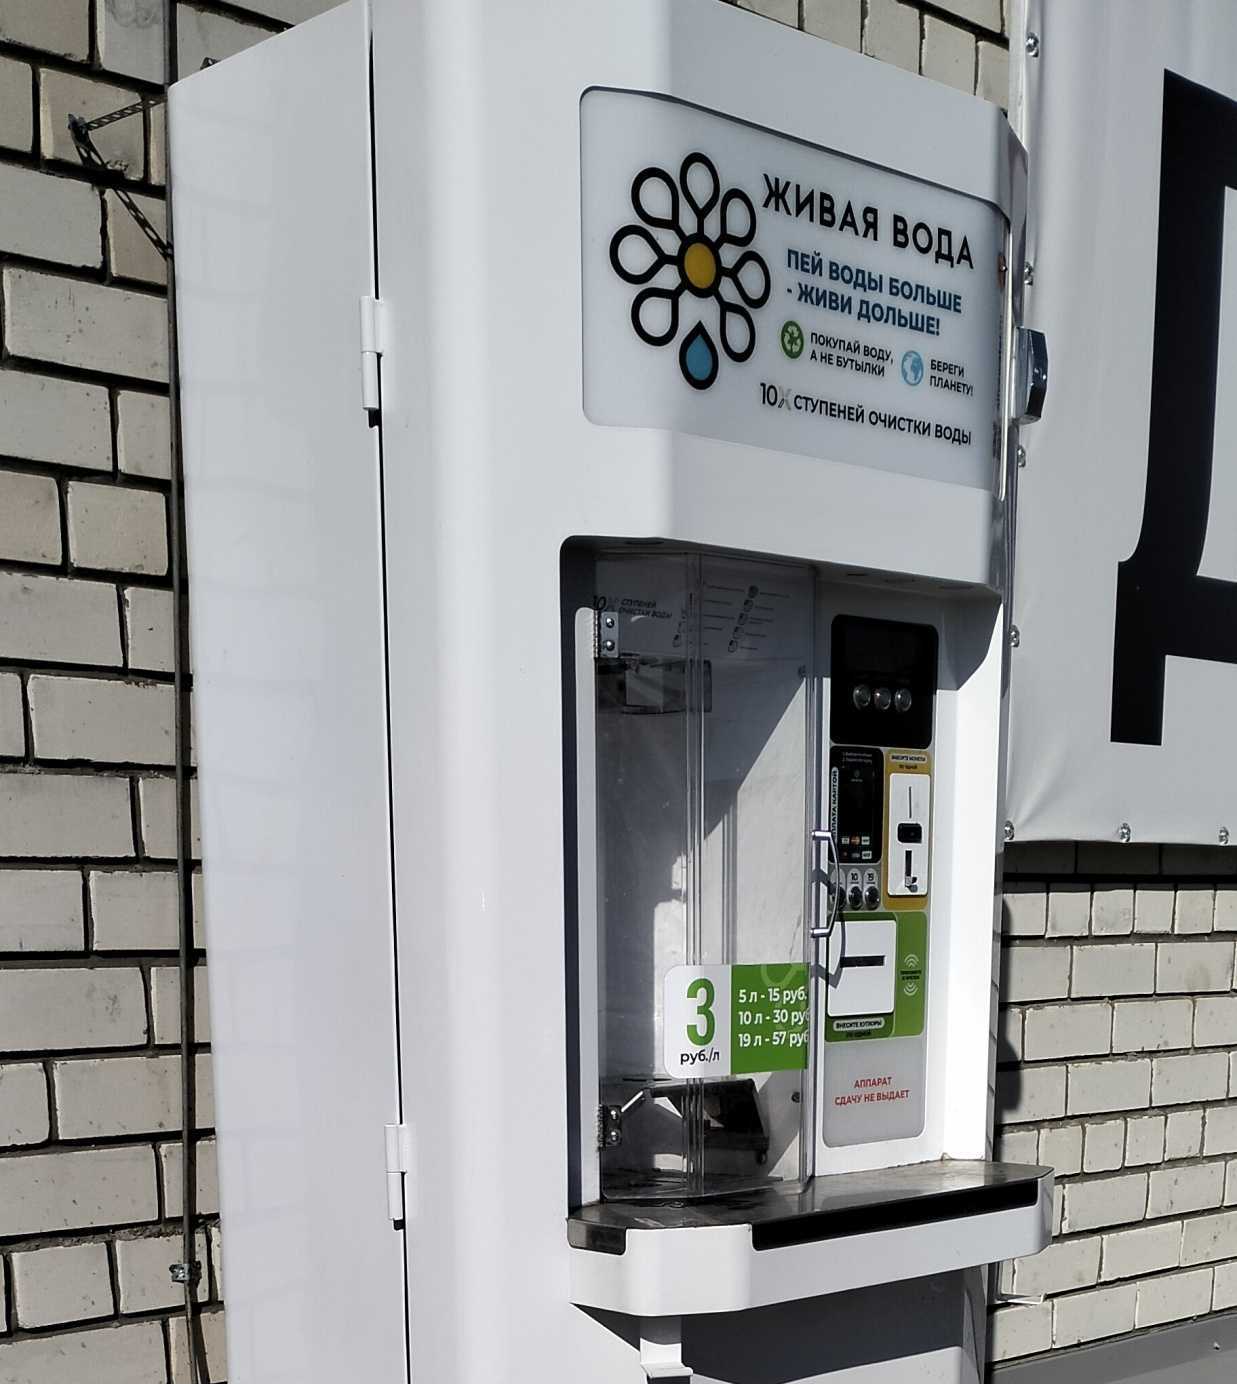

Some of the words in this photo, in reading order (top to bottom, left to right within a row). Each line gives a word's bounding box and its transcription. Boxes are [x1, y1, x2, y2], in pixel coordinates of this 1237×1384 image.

[762, 173, 879, 242] ЖИВАЯ
[893, 214, 974, 269] ВОДА
[787, 248, 823, 277] ПЕЙ
[829, 260, 883, 293] ВОДЫ
[889, 277, 962, 314] БОЛЬШЕ
[797, 282, 852, 315] ЖИВИ
[857, 299, 940, 336] ДОЛЬШЕ!
[811, 332, 860, 356] ПОКУПАЙ
[863, 345, 894, 364] ВОДУ,
[810, 350, 818, 361] А
[820, 352, 834, 366] НЕ
[836, 356, 885, 377] БУТЫЛКИ
[930, 359, 965, 378] БЕРЕГИ
[930, 375, 974, 397] ПЛАНЕТУ!
[793, 395, 865, 424] СТУПЕНЕЙ
[868, 411, 931, 437] ОЧИСТКИ
[934, 423, 972, 445] ВОДЫ
[851, 872, 859, 881] 10
[738, 988, 747, 1003] 5
[749, 990, 758, 1003] л
[767, 988, 780, 1002] 15
[783, 986, 808, 1005] руб.
[686, 977, 716, 1047] 3
[738, 1011, 752, 1025] 10
[754, 1013, 763, 1024] л
[773, 1009, 788, 1024] 30
[738, 1033, 751, 1048] 19
[753, 1034, 762, 1047] л
[772, 1031, 787, 1045] 57
[680, 1047, 720, 1065] руб./л
[853, 1076, 892, 1089] АППАРАТ
[834, 1094, 862, 1106] СДАЧУ
[864, 1092, 875, 1103] НЕ
[876, 1089, 910, 1102] ВЫДАЕТ
